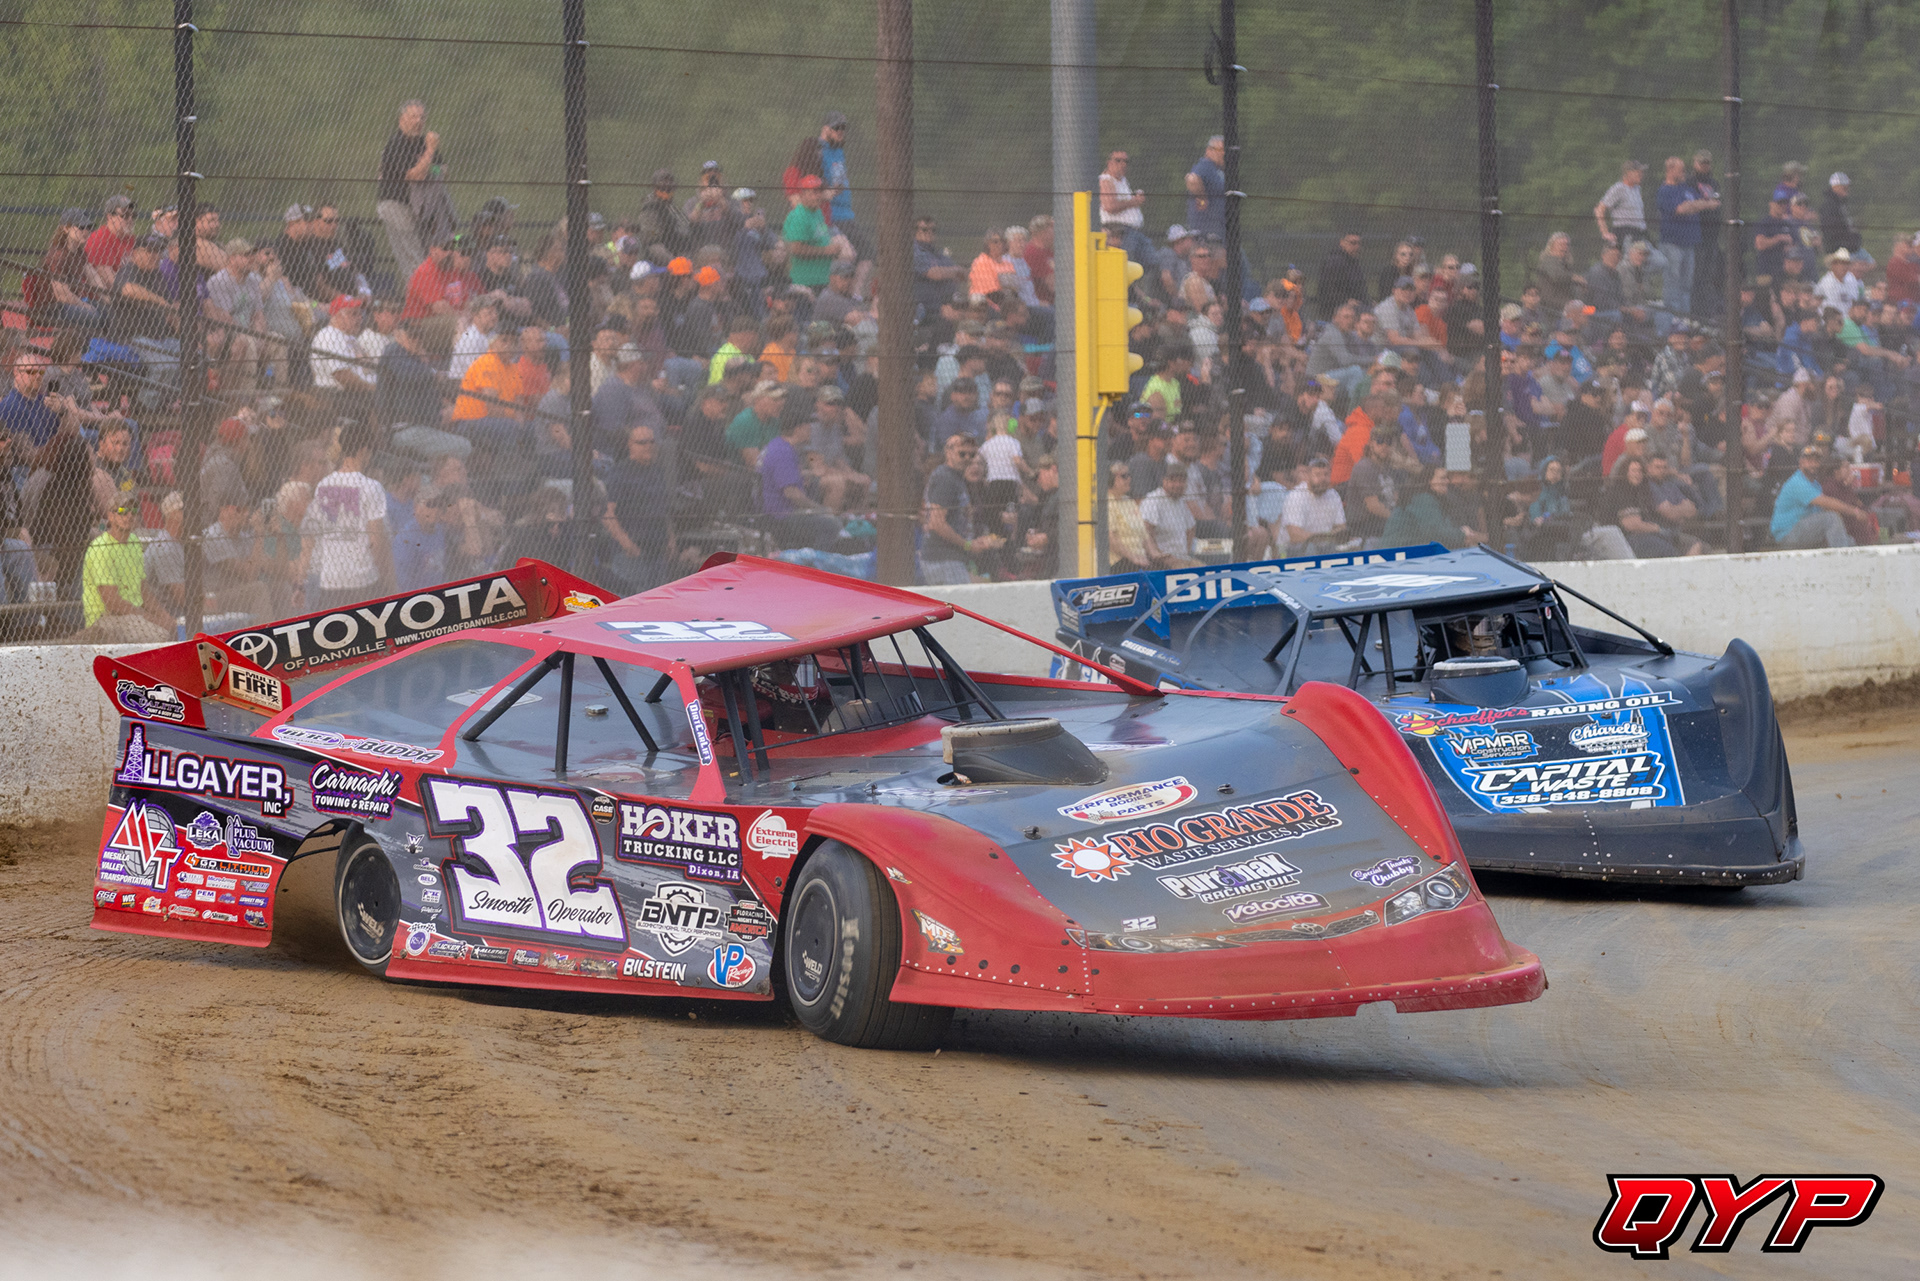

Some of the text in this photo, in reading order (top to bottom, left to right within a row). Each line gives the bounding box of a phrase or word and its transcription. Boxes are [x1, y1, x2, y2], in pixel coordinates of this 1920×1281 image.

[1166, 552, 1406, 603] BILS
[1081, 585, 1135, 604] KBC
[273, 576, 527, 658] TOYOTA
[394, 608, 527, 646] WWW.TOYOTAOFDANVILLE.COM
[602, 621, 796, 643] 32
[284, 640, 385, 671] OF DANVILLE
[233, 670, 278, 698] FIRE
[246, 672, 276, 685] MULTI
[1400, 695, 1665, 731] Schaeffer's RACING OIL
[1571, 722, 1645, 742] Chiarelli
[359, 741, 440, 761] BUDDA
[1470, 744, 1531, 755] Construction
[313, 764, 399, 800] Carnaghi
[1479, 756, 1652, 791] CAPITAL
[1530, 773, 1631, 793] WASTE
[315, 795, 390, 814] TOWING & REPAIR
[1063, 778, 1184, 815] PERFORMANCE
[1110, 792, 1153, 807] BODIES
[264, 801, 282, 814] INC
[593, 804, 614, 813] CASE
[1117, 799, 1165, 816] PARTS
[233, 819, 241, 827] A
[621, 804, 739, 848] HOKER
[756, 826, 796, 839] Extreme
[1110, 794, 1331, 859] RIO GRANDE
[189, 826, 219, 841] LEKA
[234, 828, 256, 839] PLUS
[756, 835, 796, 848] Electric
[1143, 815, 1334, 868] WASTE SERVICES, INC.
[233, 839, 272, 852] VACUUM
[624, 839, 738, 866] TRUCKING LLC
[102, 851, 130, 861] MESILLA
[430, 780, 625, 940] 32
[101, 861, 124, 871] VALLEY
[219, 861, 270, 874] LITHIUM
[689, 865, 740, 879] Dixon, IA
[1354, 865, 1383, 880] Special
[1372, 865, 1415, 886] Chubby
[100, 871, 152, 886] TRANSPORTATION
[420, 875, 435, 883] BELL
[1202, 875, 1297, 902] RACING OIL
[469, 890, 534, 915] Smooth
[547, 898, 614, 926] Operator
[642, 900, 719, 929] BNTP
[729, 922, 767, 936] AMERICA
[1123, 915, 1157, 933] 32
[623, 958, 686, 981] BILSTEIN
[714, 944, 744, 985] VP
[728, 966, 753, 981] Racing
